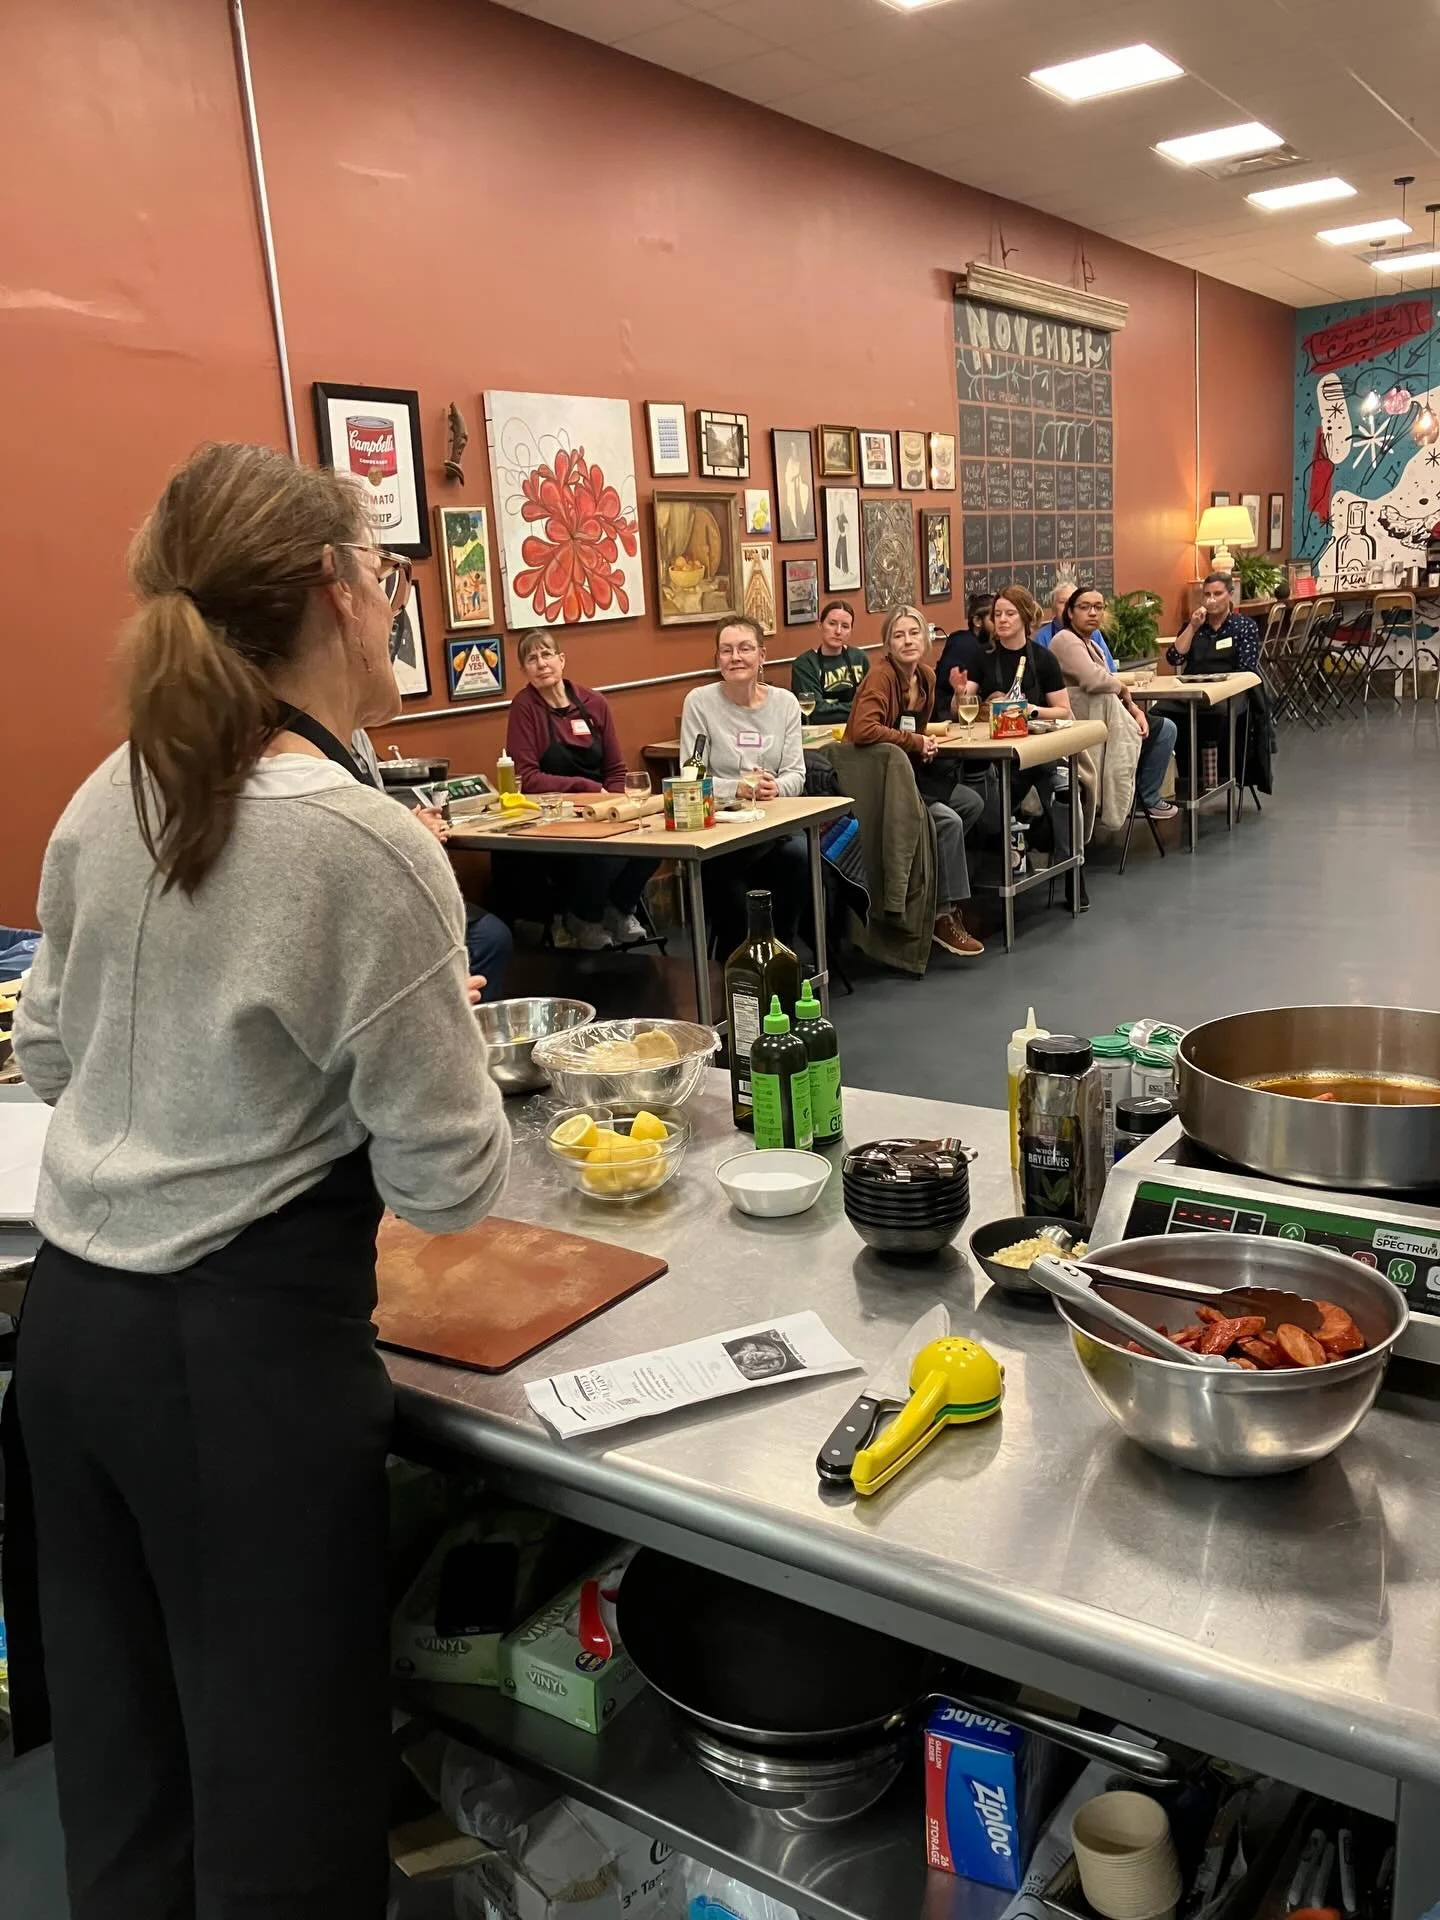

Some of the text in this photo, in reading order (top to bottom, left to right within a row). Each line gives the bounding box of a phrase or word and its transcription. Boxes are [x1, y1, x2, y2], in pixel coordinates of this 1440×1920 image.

[966, 301, 1103, 371] NOVEMBER
[1028, 1152, 1043, 1164] BAY
[1043, 1155, 1070, 1168] LEAVES
[1376, 1238, 1438, 1257] SPECTRUM
[420, 1638, 465, 1652] VINYL
[528, 1671, 566, 1696] VINYL
[971, 1779, 1012, 1857] Ziploc
[930, 1819, 940, 1865] STORAGE
